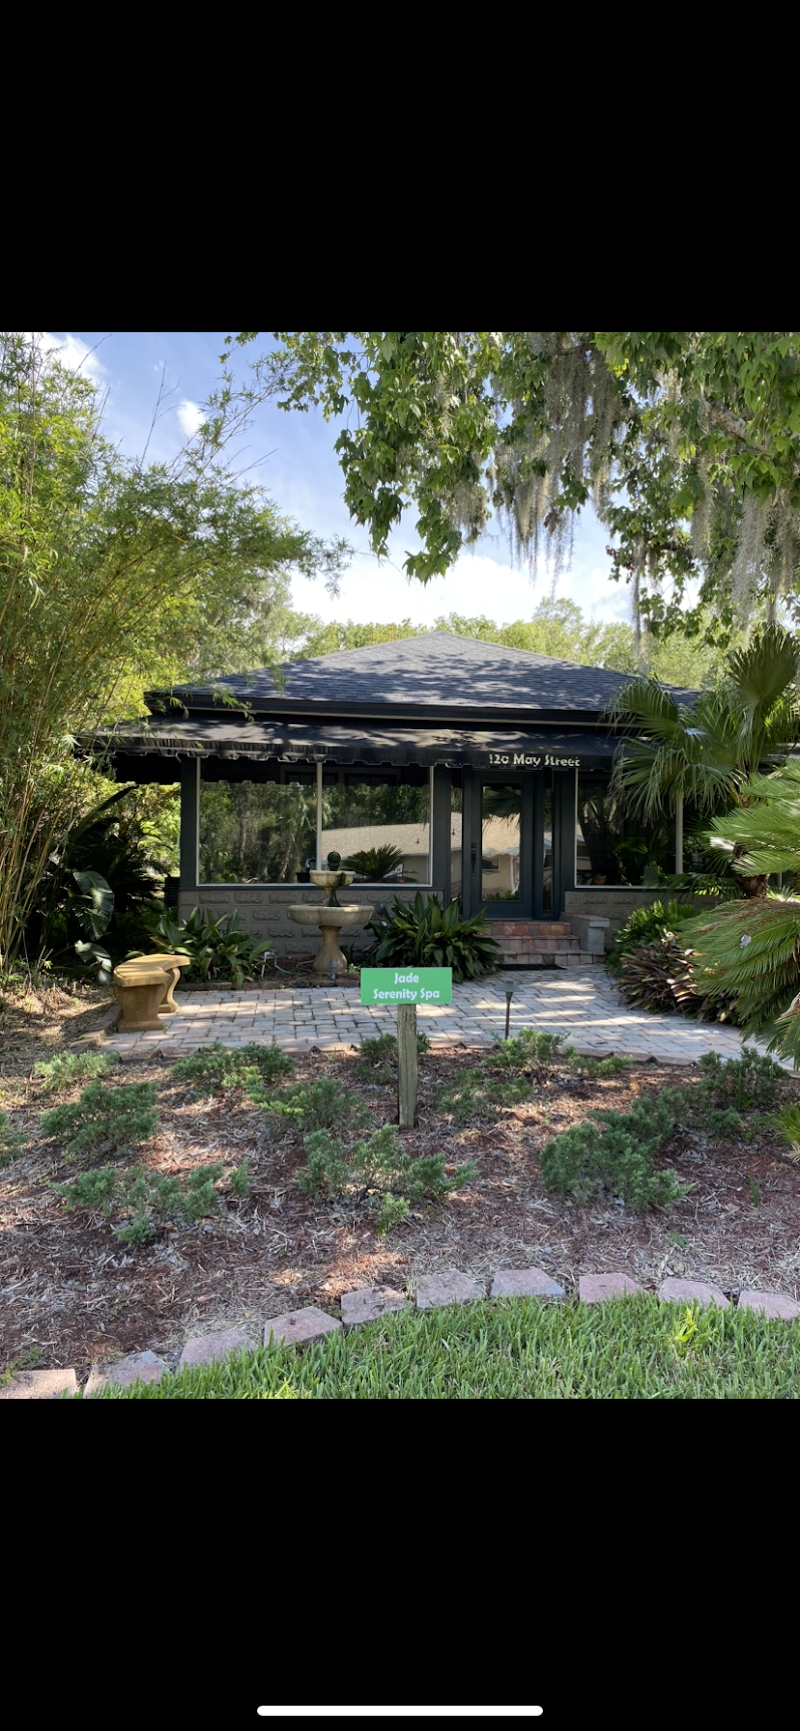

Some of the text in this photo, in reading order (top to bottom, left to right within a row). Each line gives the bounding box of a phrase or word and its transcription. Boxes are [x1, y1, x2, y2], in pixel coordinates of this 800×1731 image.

[489, 753, 580, 767] 120 May Street
[394, 972, 420, 985] Jade
[373, 987, 440, 1001] Serenity Spa
